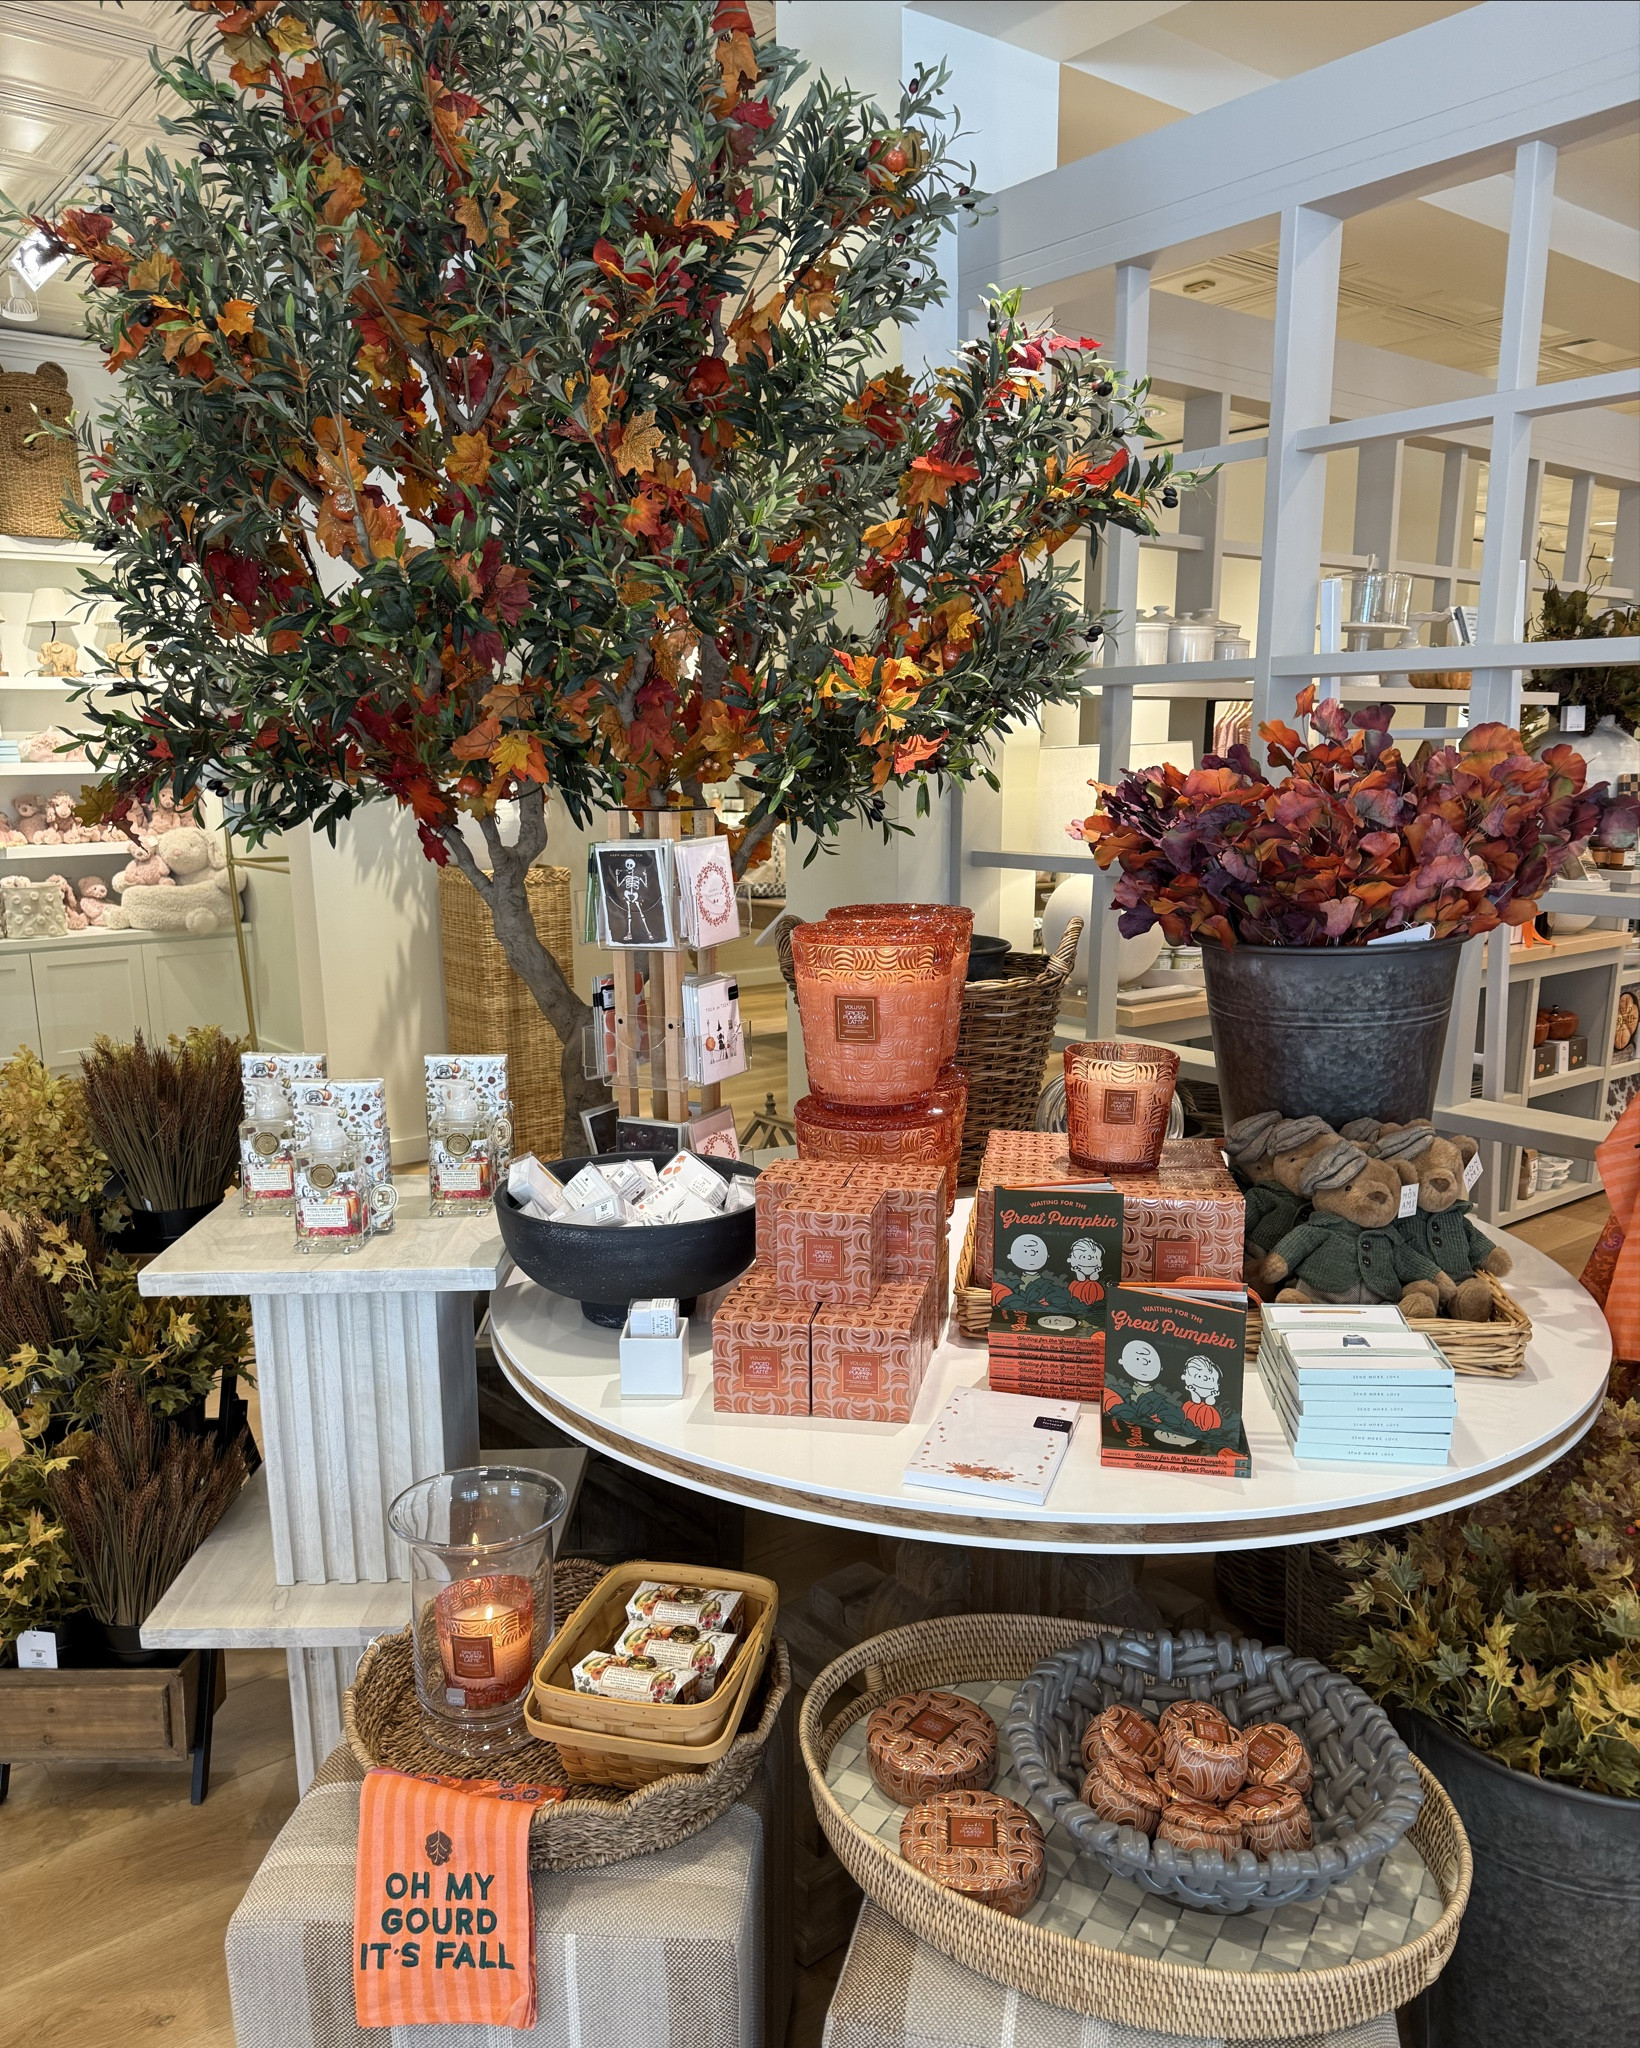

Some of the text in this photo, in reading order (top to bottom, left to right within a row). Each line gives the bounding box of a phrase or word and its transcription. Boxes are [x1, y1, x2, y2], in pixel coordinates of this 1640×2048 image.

[1402, 1191, 1416, 1199] MON
[1030, 1199, 1059, 1208] WAITING
[1075, 1202, 1088, 1210] THE
[999, 1209, 1118, 1229] Great Pumpkin
[1142, 1306, 1204, 1324] WAITING FOR THE
[1017, 1335, 1039, 1343] Waiting
[1110, 1310, 1237, 1350] Great Pumpkin
[1018, 1360, 1039, 1368] Waiting
[1126, 1425, 1149, 1447] Great
[1134, 1452, 1158, 1461] Waiting
[1181, 1455, 1199, 1464] Great
[1200, 1457, 1228, 1467] Pumpkin
[1134, 1461, 1158, 1470] Waiting
[1180, 1465, 1198, 1474] Great
[1199, 1467, 1227, 1476] Pumpkin
[385, 1872, 495, 1901] OH MY
[381, 1907, 498, 1935] GOURD
[360, 1941, 515, 1970] IT'S FALL
